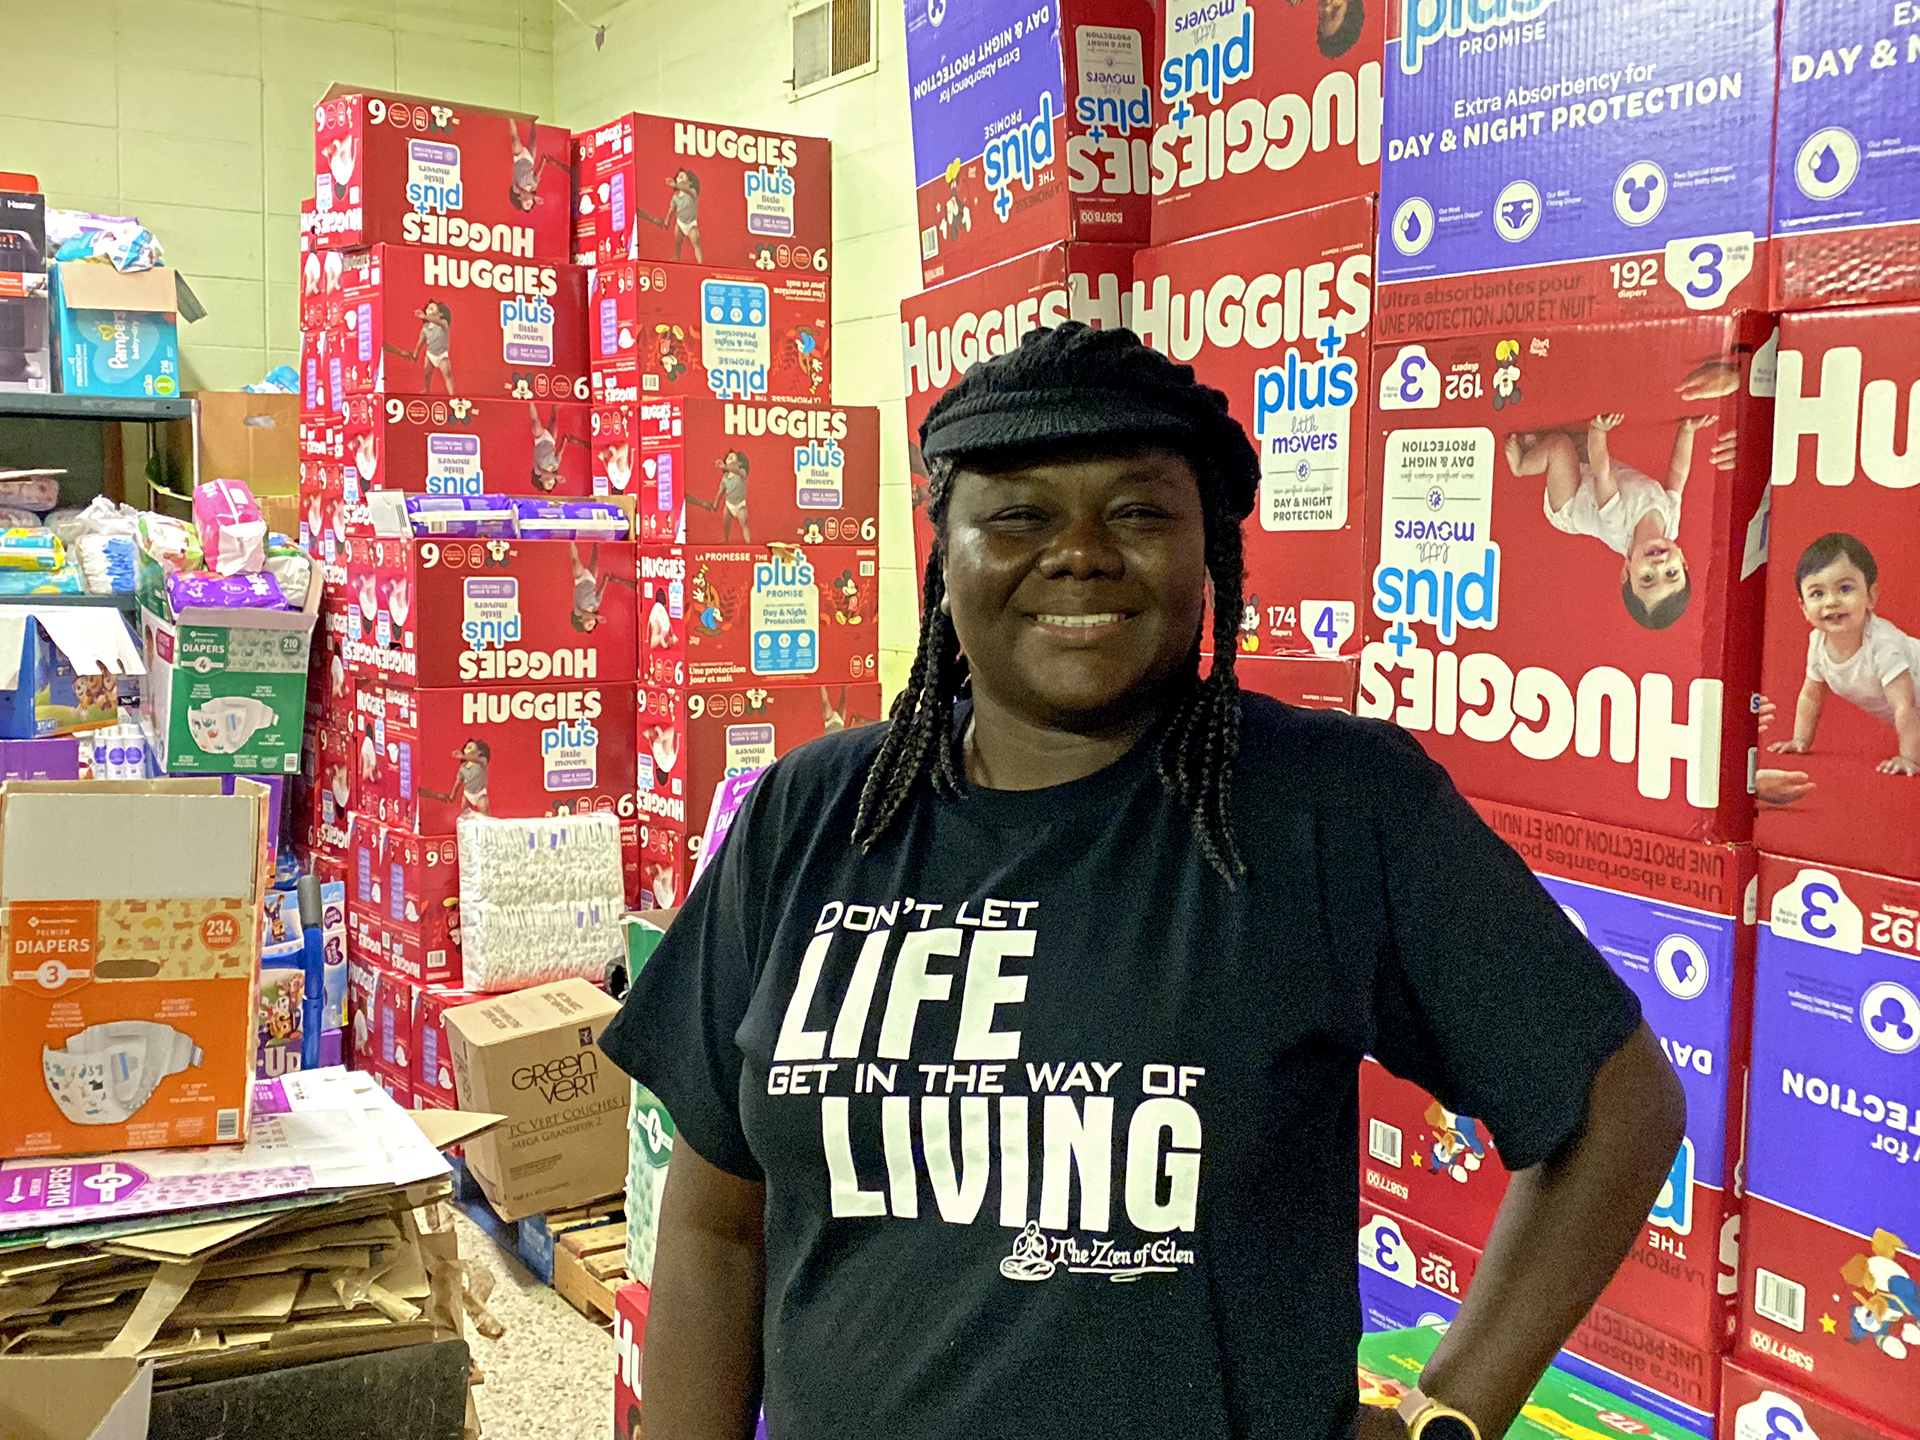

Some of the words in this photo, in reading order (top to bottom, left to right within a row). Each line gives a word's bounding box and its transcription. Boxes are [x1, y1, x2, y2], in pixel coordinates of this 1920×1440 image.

[1014, 22, 1024, 39] &
[1026, 5, 1050, 34] DAY
[1175, 0, 1236, 33] movers
[978, 31, 1013, 63] NIGHT
[1086, 31, 1132, 42] PROTECTION
[1459, 21, 1546, 58] PROMISE
[997, 47, 1021, 68] Extra
[1163, 12, 1251, 99] plus
[1791, 44, 1863, 84] DAY
[1870, 39, 1897, 70] &
[913, 53, 976, 101] PROTECTION
[950, 58, 997, 98] Absorbency
[1086, 71, 1135, 86] movers
[1453, 95, 1501, 119] Extra
[1504, 69, 1622, 109] Absorbency
[1624, 62, 1657, 85] for
[939, 89, 950, 104] for
[1079, 88, 1150, 133] plus
[984, 109, 1022, 139] PROMISE
[1151, 61, 1384, 196] HUGGIES
[1388, 132, 1434, 161] DAY
[1440, 129, 1457, 152] &
[1463, 112, 1545, 148] NIGHT
[1551, 73, 1742, 132] PROTECTION
[674, 123, 798, 168] HUGGIES
[985, 97, 1052, 186] plus
[747, 169, 793, 196] plus
[1038, 169, 1055, 187] THE
[7, 200, 37, 210] Heater
[409, 184, 461, 212] plus
[403, 213, 535, 258] HUGGIES
[813, 248, 829, 271] 6
[1610, 258, 1658, 290] 192
[1686, 242, 1724, 298] 3
[424, 253, 557, 297] HUGGIES
[1381, 287, 1421, 311] Ultra
[1425, 278, 1534, 303] absorbantes
[1538, 275, 1584, 296] pour
[1617, 287, 1648, 299] diapers
[503, 298, 552, 326] plus
[1132, 254, 1371, 362] HUGGIES
[1380, 315, 1405, 336] UNE
[1408, 303, 1495, 334] PROTECTION
[1497, 301, 1535, 325] JOUR
[1537, 300, 1557, 321] ET
[1559, 294, 1597, 320] NUIT
[109, 311, 129, 369] Pampers
[718, 357, 755, 366] PROMISE
[1452, 363, 1479, 372] diapers
[573, 377, 590, 400] 6
[711, 365, 765, 398] plus
[1400, 355, 1427, 402] 3
[1445, 374, 1483, 400] 192
[1257, 353, 1354, 434] plus
[725, 404, 848, 440] HUGGIES
[1290, 416, 1319, 434] little
[797, 443, 842, 472] plus
[1272, 432, 1338, 454] movers
[1401, 440, 1476, 453] PROTECTION
[1401, 456, 1438, 468] NIGHT
[1440, 456, 1450, 467] &
[1456, 456, 1475, 468] DAY
[429, 472, 481, 494] plus
[1273, 497, 1292, 508] DAY
[1293, 497, 1301, 507] &
[1303, 496, 1332, 508] NIGHT
[1273, 509, 1333, 522] PROTECTION
[861, 517, 876, 540] 6
[1394, 520, 1475, 542] movers
[641, 556, 686, 579] HUGGIES
[695, 554, 705, 562] LA
[705, 552, 751, 562] PROMESSE
[757, 557, 812, 593] plus
[766, 589, 803, 598] PROMISE
[1377, 548, 1494, 637] plus
[465, 615, 519, 645] plus
[764, 616, 806, 625] Protection
[1267, 606, 1297, 627] 174
[1313, 606, 1338, 648] 4
[283, 638, 298, 649] 210
[1271, 628, 1292, 637] diapers
[182, 643, 225, 654] DIAPERS
[865, 654, 875, 668] 6
[199, 659, 207, 670] 4
[459, 648, 597, 680] HUGGIES
[674, 662, 684, 685] 6
[689, 665, 703, 675] Une
[705, 664, 746, 675] protection
[462, 691, 602, 725] HUGGIES
[544, 724, 596, 755] plus
[1359, 642, 1723, 808] HUGGIES
[618, 793, 634, 817] 6
[638, 790, 684, 822] HUGGIES
[1493, 810, 1522, 832] NUIT
[1525, 818, 1542, 838] ET
[1546, 821, 1584, 848] JOUR
[1586, 831, 1685, 871] PROTECTION
[1689, 855, 1725, 878] UNE
[814, 897, 942, 933] DON'T
[955, 898, 1039, 929] LET
[1801, 882, 1839, 939] 3
[206, 919, 234, 937] 234
[15, 938, 90, 954] DIAPERS
[46, 965, 59, 983] 3
[773, 929, 1038, 1061] LIFE
[1660, 1037, 1712, 1075] DAY
[768, 1063, 838, 1095] GET
[855, 1064, 898, 1093] IN
[918, 1064, 1006, 1093] THE
[1026, 1061, 1122, 1093] WAY
[1142, 1063, 1206, 1097] OF
[510, 1123, 527, 1137] PC
[512, 1136, 541, 1150] MEGA
[541, 1123, 594, 1143] GRANDEUR
[595, 1117, 604, 1126] 2
[1871, 1133, 1909, 1163] for
[822, 1096, 1202, 1232] LIVING
[46, 1166, 73, 1207] DIAPERS
[93, 1177, 123, 1185] 5
[1051, 1236, 1089, 1264] The
[1091, 1239, 1131, 1266] Zen
[1134, 1241, 1151, 1268] of
[1375, 1226, 1401, 1272] 3
[1648, 1229, 1687, 1260] THE
[1421, 1256, 1460, 1294] 192
[1602, 1411, 1643, 1434] 172
